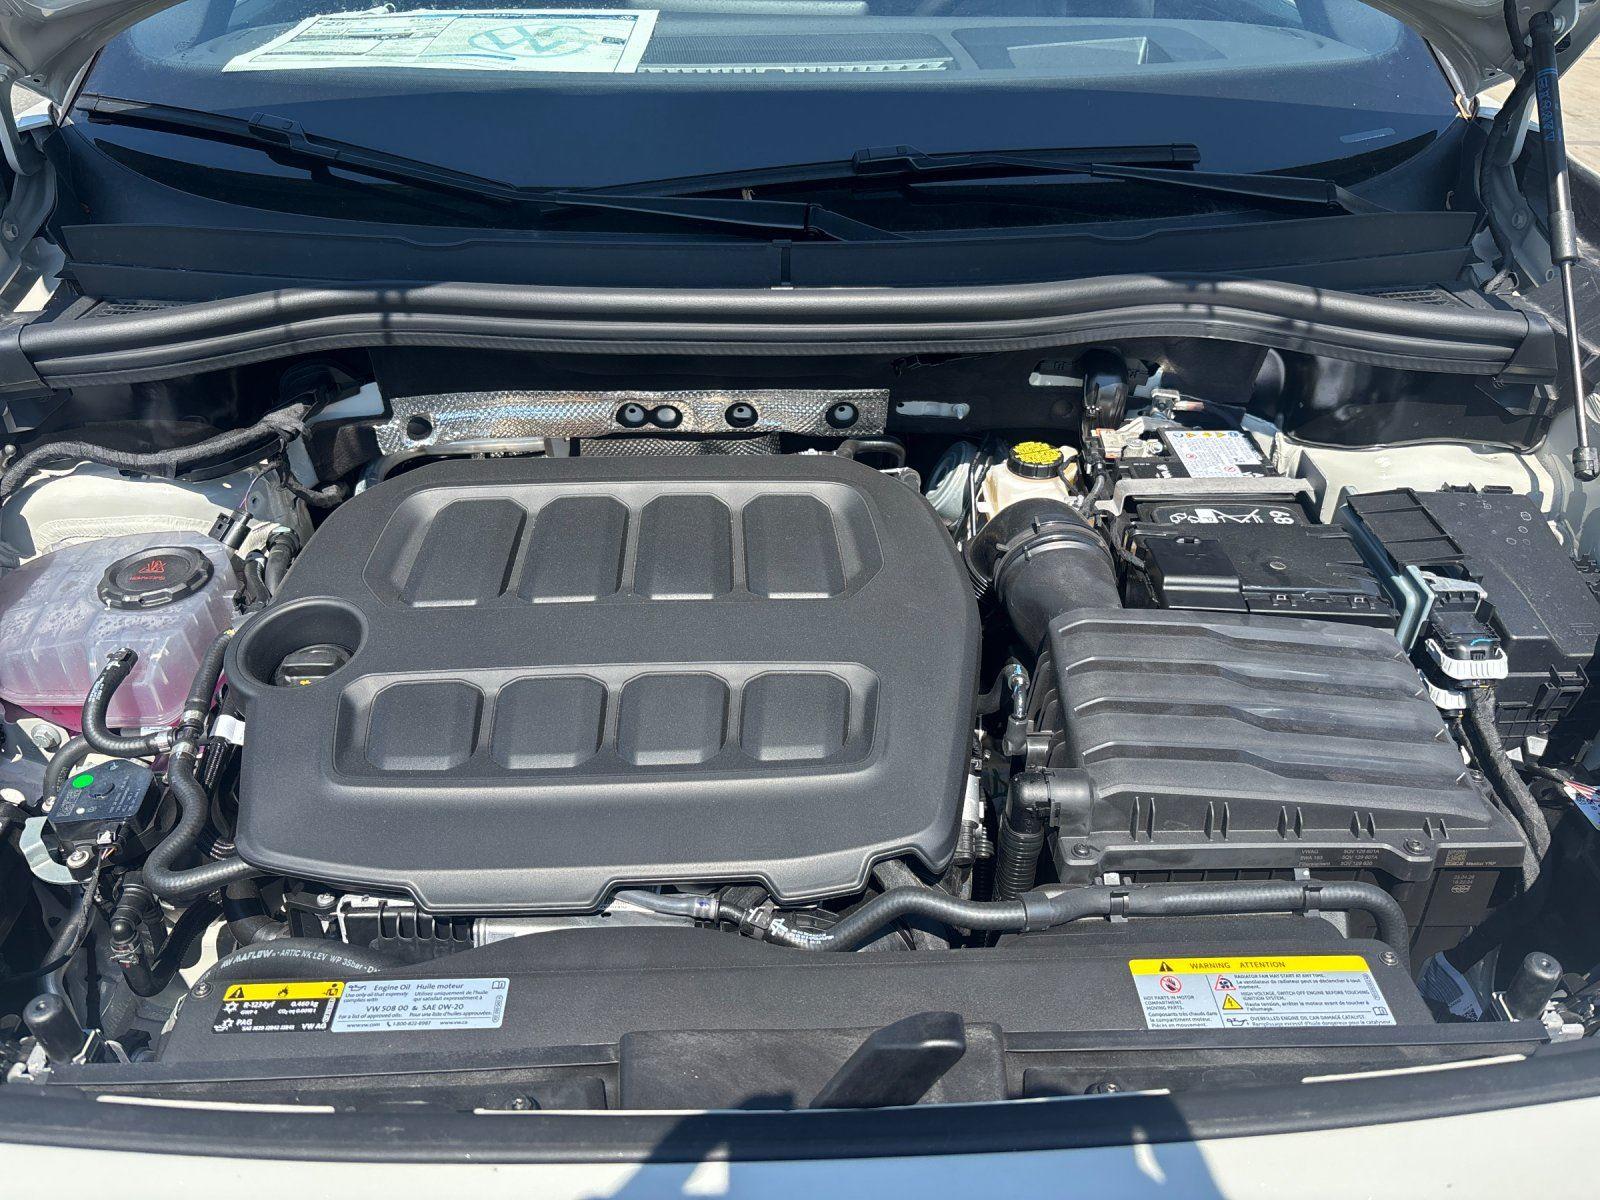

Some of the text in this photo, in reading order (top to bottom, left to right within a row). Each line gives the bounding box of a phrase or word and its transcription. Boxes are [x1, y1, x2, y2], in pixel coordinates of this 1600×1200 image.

[279, 949, 301, 957] ARTIC
[312, 951, 328, 961] LEV
[330, 954, 342, 964] WP
[342, 957, 364, 970] 35bar
[1239, 961, 1286, 969] ATTENTION
[373, 984, 399, 992] Engine
[242, 1002, 276, 1010] R-1234yf
[315, 1022, 327, 1030] AG
